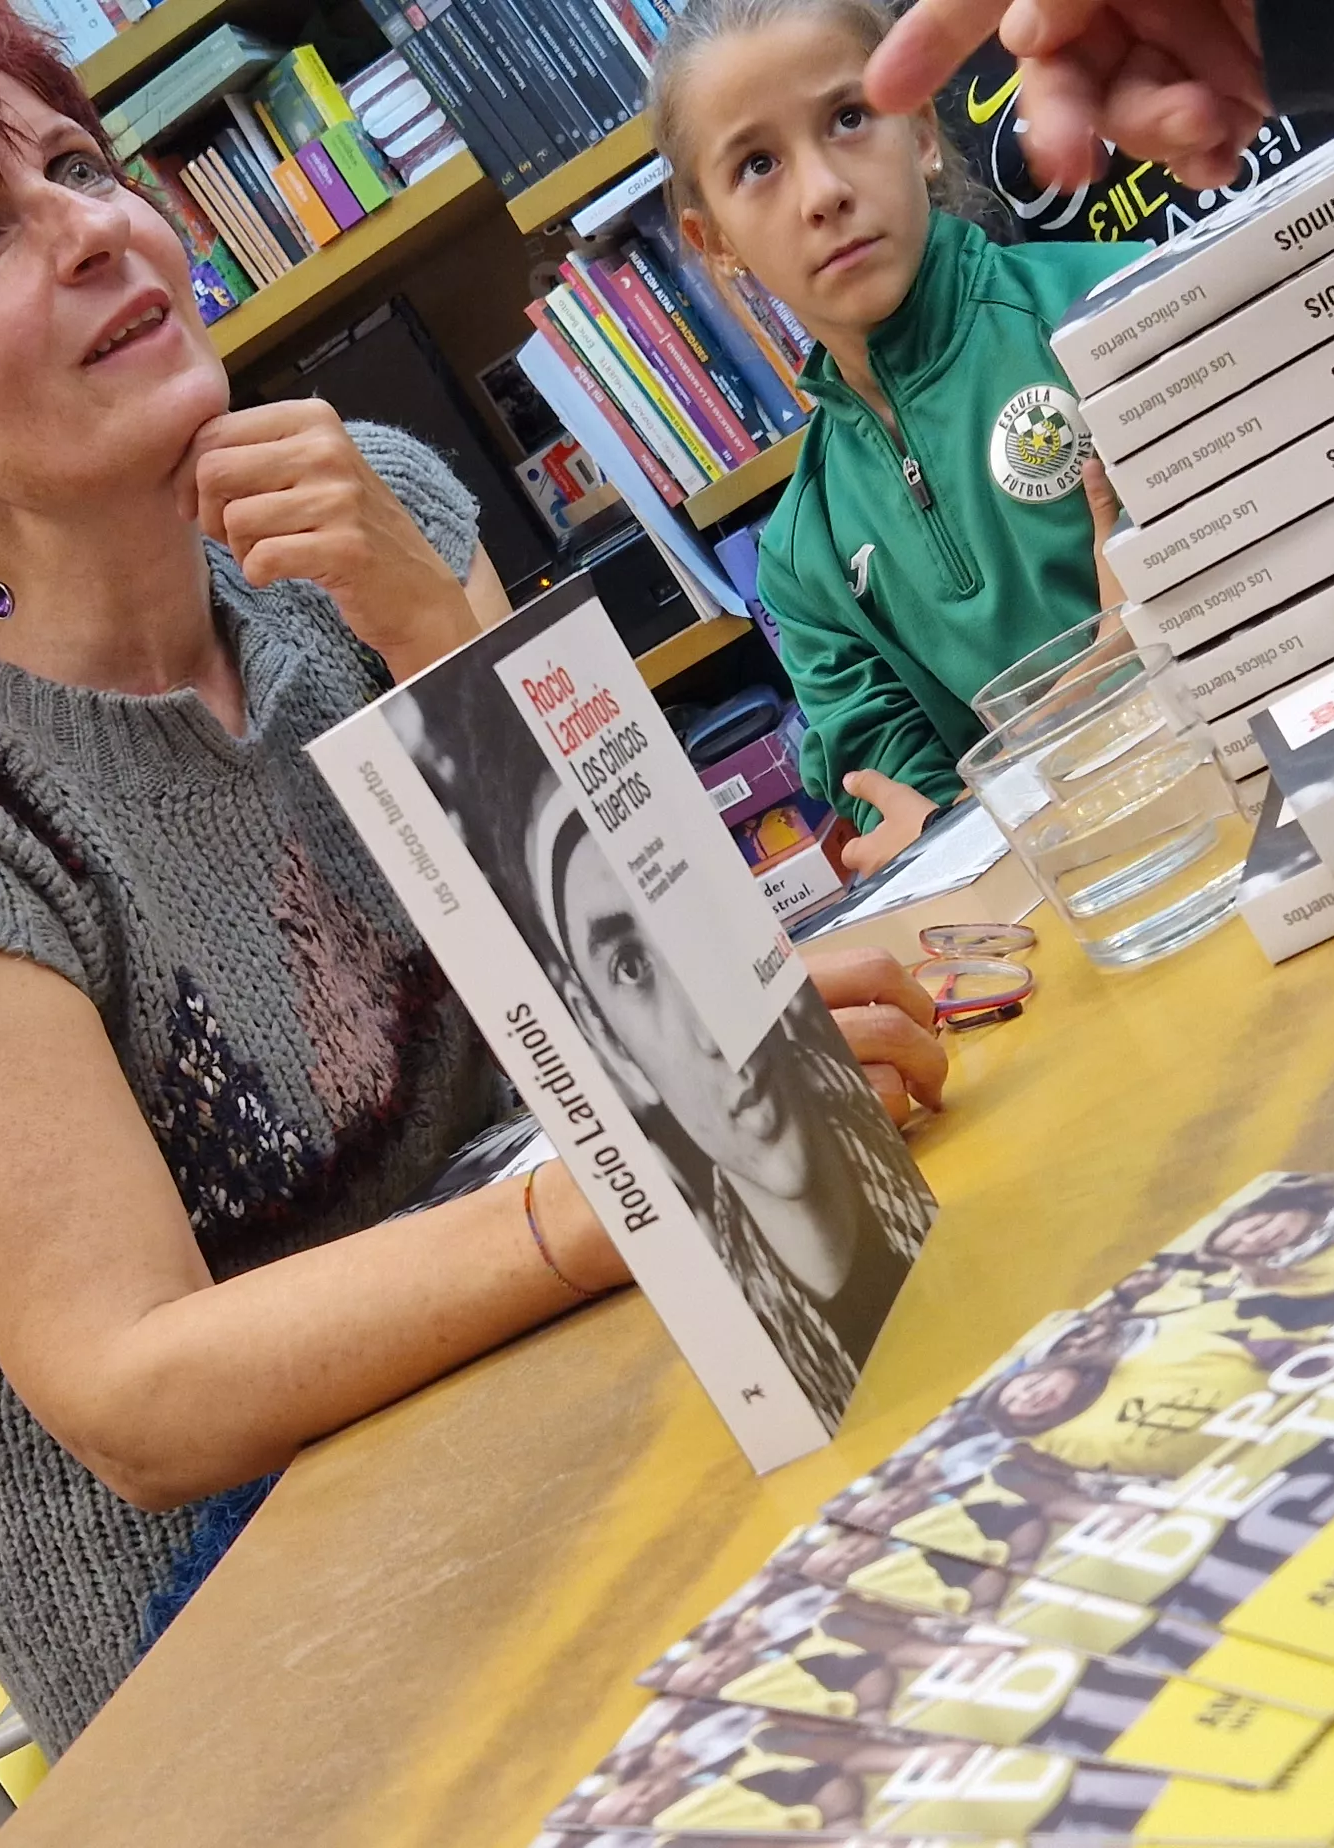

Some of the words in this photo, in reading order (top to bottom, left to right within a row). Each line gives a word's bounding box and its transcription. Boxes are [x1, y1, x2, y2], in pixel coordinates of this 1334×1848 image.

[1184, 283, 1208, 307] Los
[1137, 301, 1181, 334] chicos
[1090, 326, 1137, 361] tuertos
[1212, 351, 1237, 373] Los
[1165, 366, 1210, 399] chicos
[998, 389, 1051, 430] ESCUELA
[1117, 393, 1167, 428] tuertos
[1237, 416, 1262, 440] Los
[1193, 432, 1237, 462] chicos
[1002, 473, 1052, 498] FÚTBOL
[1056, 432, 1093, 489] OSCENSE
[1145, 455, 1194, 490] tuertos
[1235, 500, 1259, 522] Los
[1190, 514, 1235, 545] chicos
[1143, 537, 1191, 570] tuertos
[1205, 580, 1248, 611] chicos
[1248, 568, 1273, 591] Los
[1158, 602, 1206, 635] tuertos
[1237, 646, 1279, 678] chicos
[1279, 634, 1304, 658] Los
[521, 660, 576, 717] Rocío
[544, 683, 621, 758] Lardinois
[568, 760, 608, 797] Los
[601, 720, 649, 775] chicos
[357, 759, 407, 834] tuertos
[591, 771, 652, 834] tuertos
[406, 831, 443, 881] chicos
[434, 881, 460, 916] Los
[505, 1002, 608, 1149] Lardinois
[592, 1145, 660, 1236] Rocío
